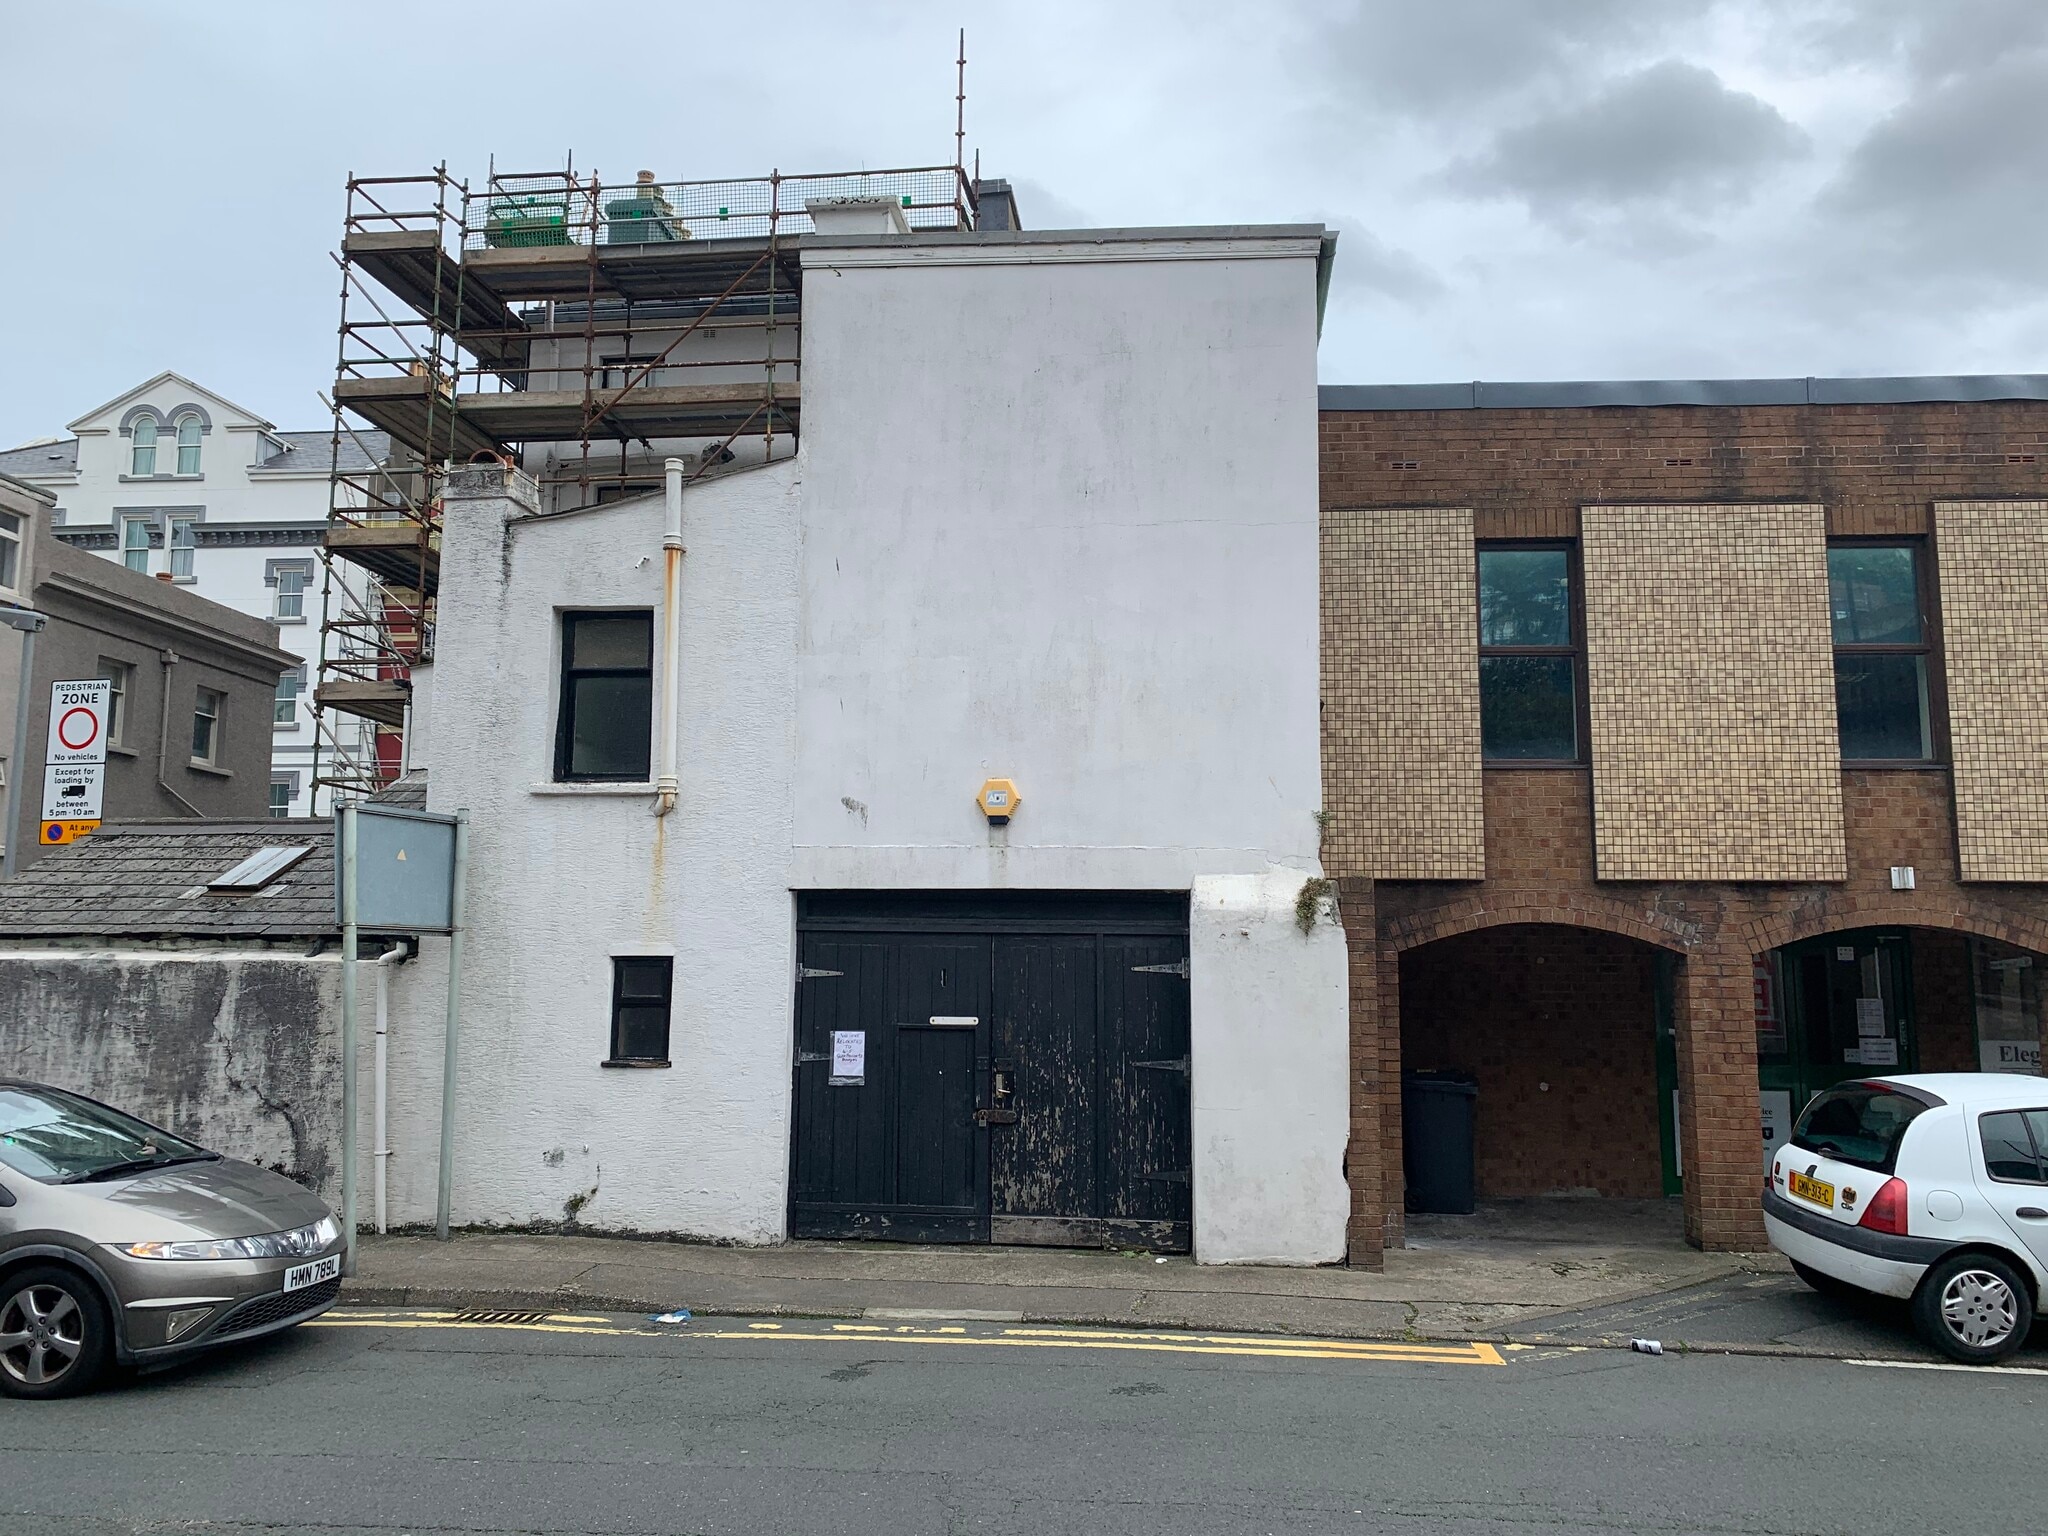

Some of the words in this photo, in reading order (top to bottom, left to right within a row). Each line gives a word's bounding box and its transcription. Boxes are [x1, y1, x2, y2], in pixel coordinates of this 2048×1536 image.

[55, 683, 107, 691] PEDESTRIAN
[61, 693, 98, 704] ZONE
[67, 753, 98, 761] vehicles
[55, 768, 81, 776] Except
[54, 776, 82, 784] loading
[84, 776, 94, 784] by
[987, 793, 1007, 803] ADT
[73, 808, 82, 816] 10
[81, 825, 94, 833] any
[290, 1265, 313, 1288] HMN
[314, 1258, 337, 1281] 789L
